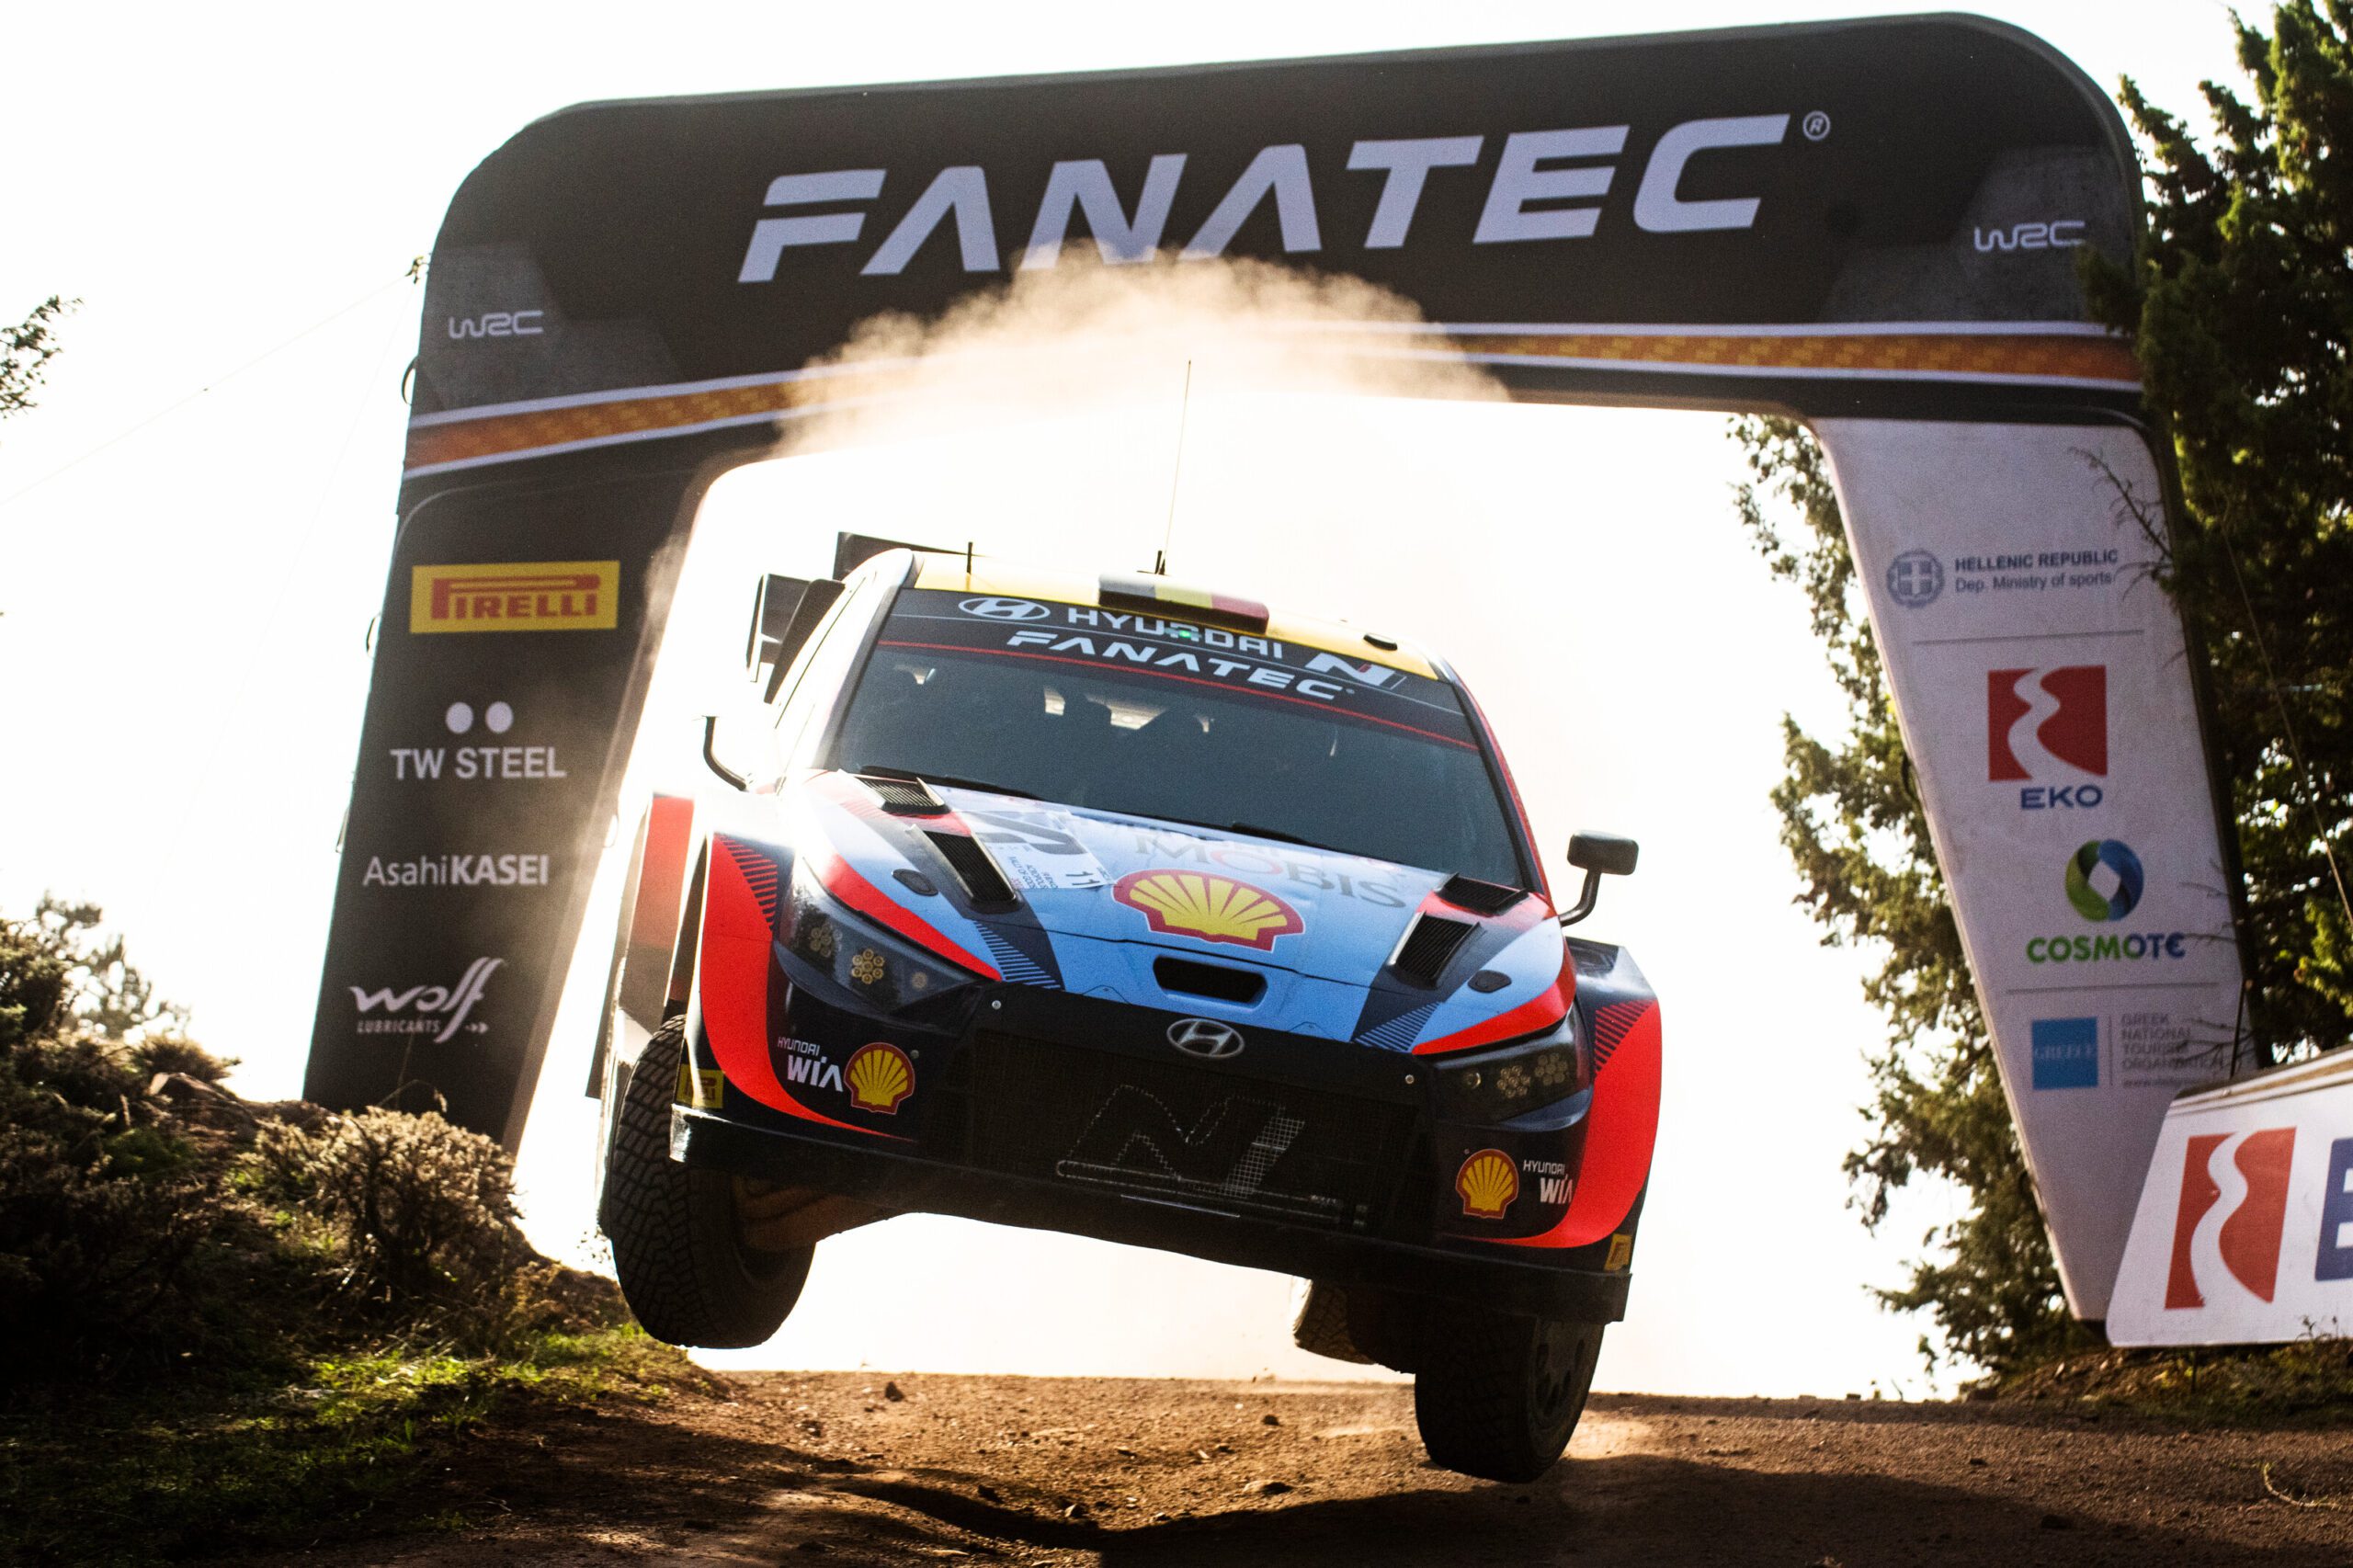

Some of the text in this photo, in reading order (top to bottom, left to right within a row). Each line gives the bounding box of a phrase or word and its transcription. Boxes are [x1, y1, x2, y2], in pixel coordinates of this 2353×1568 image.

[738, 114, 1790, 282] FANATEC
[1973, 220, 2086, 252] WRC
[448, 310, 544, 339] WRC
[1955, 549, 2118, 573] HELLENIC REPUBLIC
[1993, 574, 2047, 591] Ministry
[2052, 572, 2065, 586] of
[2069, 571, 2112, 590] sports
[430, 574, 600, 620] PIRELLI
[1007, 631, 1343, 699] FANATEC
[390, 746, 567, 779] TW STEEL
[2021, 784, 2104, 810] EKO
[1135, 834, 1406, 908] MOBIS
[357, 1018, 441, 1034] LUBRICANTS
[778, 1037, 820, 1056] HYUNDAI
[788, 1055, 844, 1092] WIA
[1523, 1160, 1565, 1175] HYUNDAI
